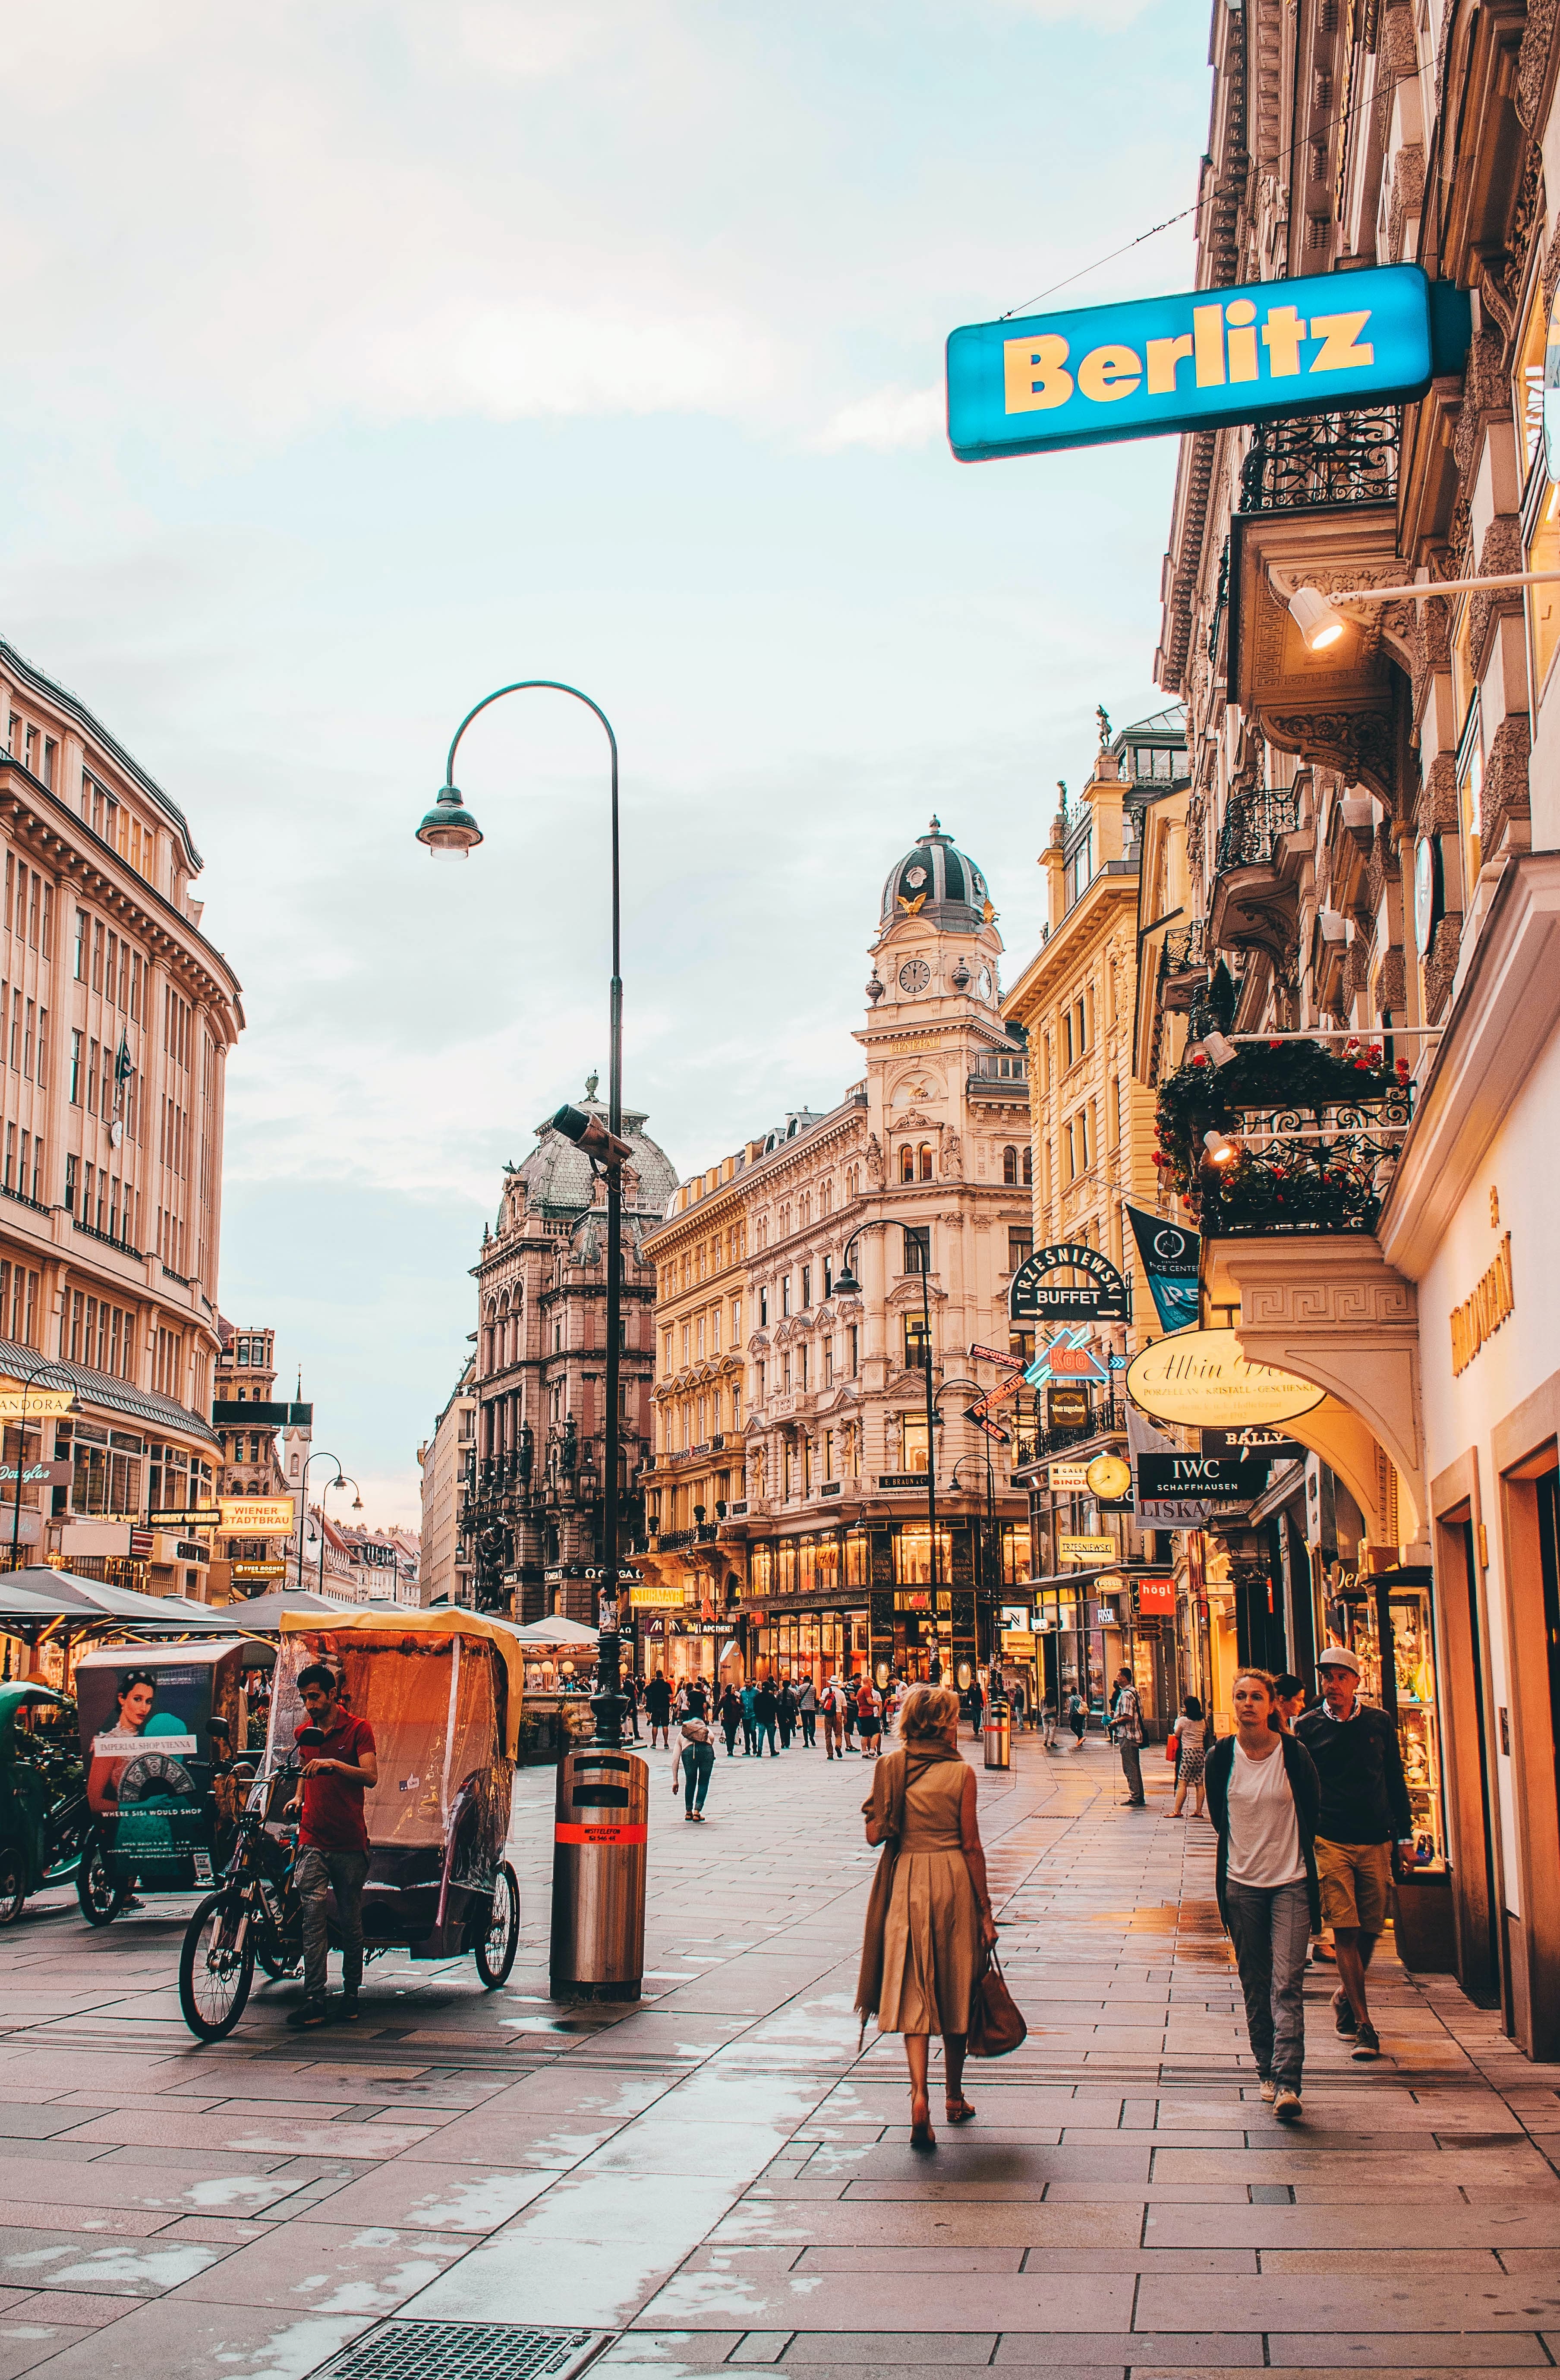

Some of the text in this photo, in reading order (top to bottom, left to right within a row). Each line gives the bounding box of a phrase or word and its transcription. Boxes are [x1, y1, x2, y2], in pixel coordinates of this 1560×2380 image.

[1003, 299, 1374, 414] Berlitz
[889, 1037, 941, 1053] GENERALI
[1037, 1291, 1100, 1304] BUFFET
[974, 1345, 1024, 1365] DISCOTHEQUE
[1144, 1354, 1222, 1381] Albin
[1206, 1386, 1250, 1395] KRISTALL
[1257, 1384, 1315, 1393] GESCHENKE
[1172, 1460, 1220, 1478] IWC
[1139, 1501, 1207, 1518] LISKA
[150, 1513, 184, 1523] GERRY
[184, 1512, 220, 1523] WEBER
[818, 1552, 836, 1564] H&M
[548, 1572, 558, 1580] OMEGA
[1097, 1608, 1114, 1622] FOSSIL
[100, 1740, 191, 1751] IMPERIAL SHOP VIENNA
